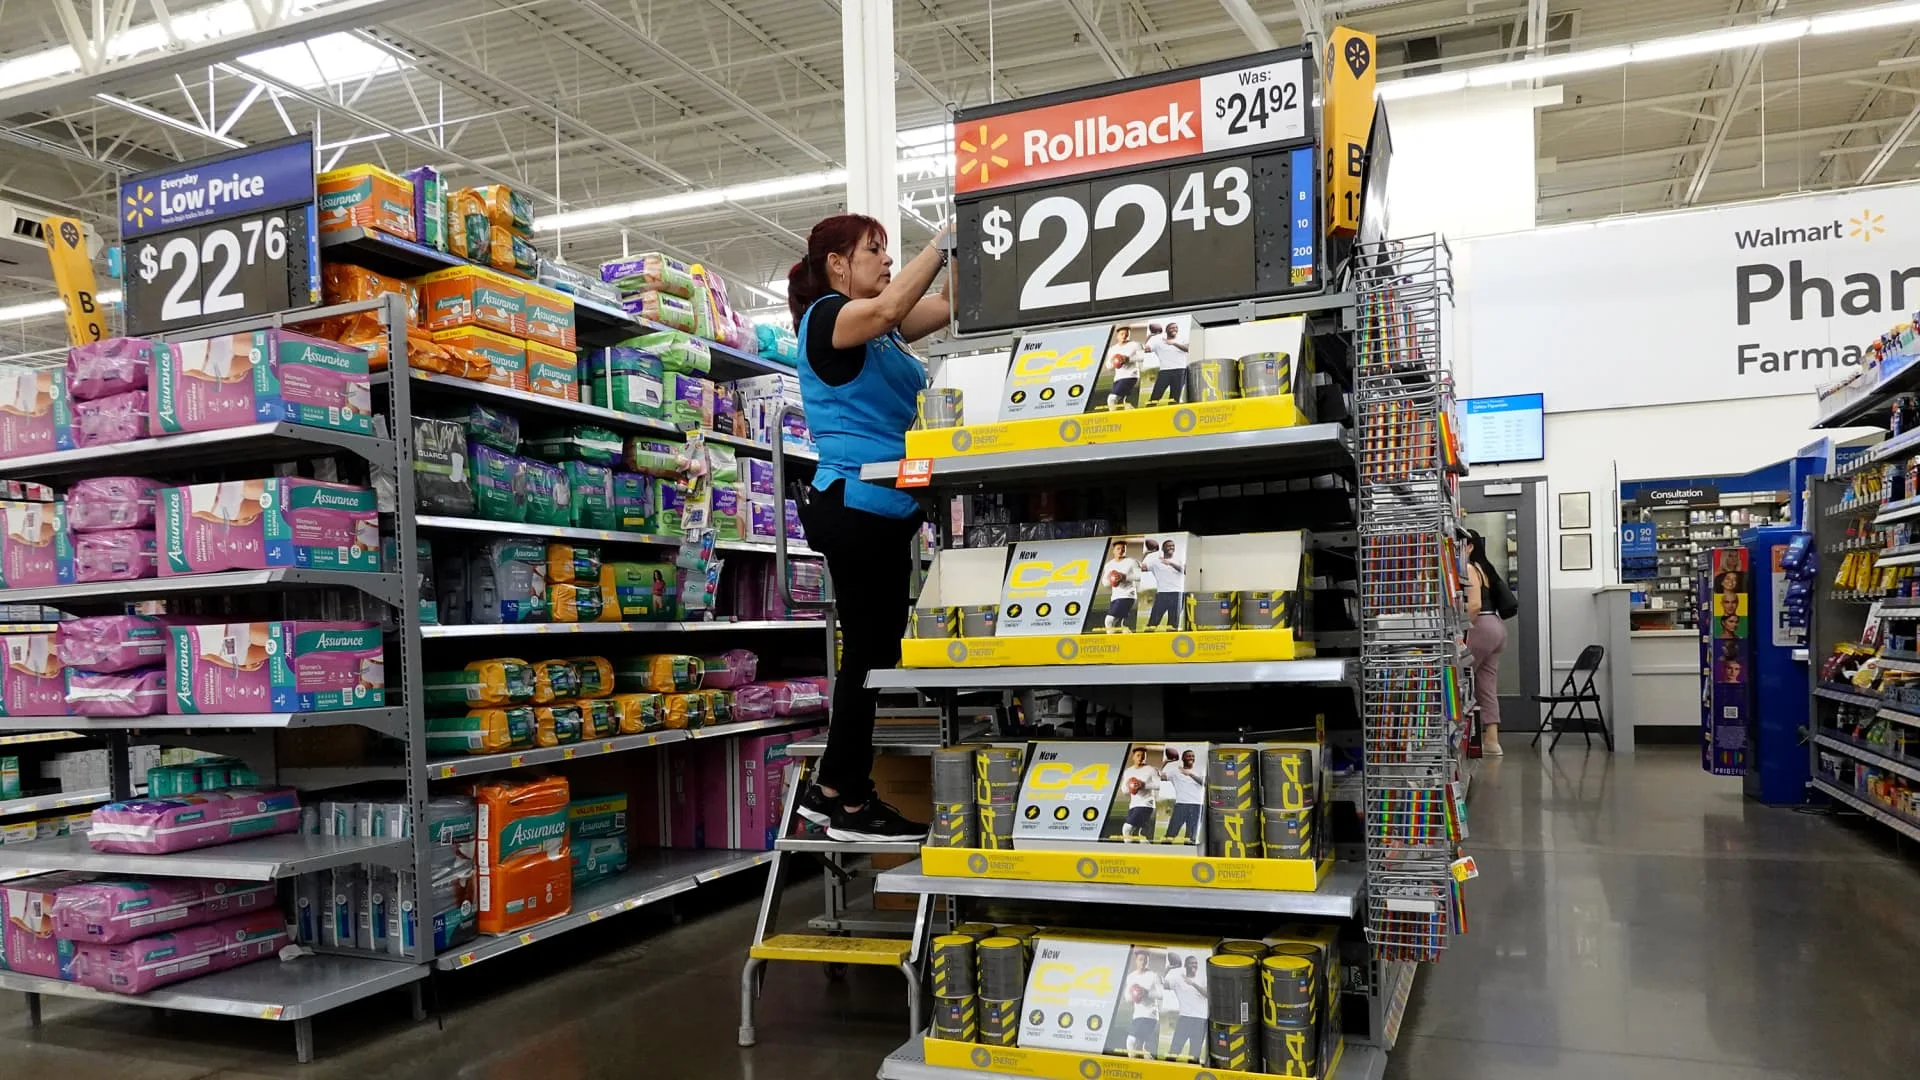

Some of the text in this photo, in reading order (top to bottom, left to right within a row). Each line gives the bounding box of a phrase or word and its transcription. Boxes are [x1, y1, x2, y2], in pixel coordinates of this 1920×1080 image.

[1238, 69, 1272, 87] Was:
[1023, 102, 1196, 167] Rollback
[160, 173, 199, 190] Everyday
[160, 173, 264, 216] Low Price
[1298, 191, 1306, 201] B
[1296, 219, 1309, 229] 10
[1735, 219, 1843, 250] Walmart
[1293, 246, 1313, 257] 200
[78, 290, 95, 314] B
[482, 289, 520, 312] Assurance
[533, 306, 569, 327] Assurance
[88, 322, 100, 342] 9
[1024, 341, 1043, 352] New
[301, 346, 350, 368] Assurance
[1013, 344, 1096, 377] C4
[537, 363, 572, 382] Assurance
[159, 352, 175, 425] Assurance
[1082, 424, 1122, 435] HYDRATION
[417, 450, 449, 461] GUARDS
[312, 489, 359, 507] Assurance
[1650, 489, 1703, 499] Consultation
[168, 493, 184, 565] Assurance
[1640, 528, 1652, 536] 90
[1019, 550, 1038, 560] New
[1009, 559, 1092, 589] C4
[315, 632, 364, 649] Assurance
[1079, 644, 1120, 654] HYDRATION
[1197, 642, 1226, 651] POWER
[177, 634, 192, 707] Assurance
[1039, 751, 1059, 761] New
[977, 753, 991, 805] C4
[1028, 762, 1111, 792] C4
[1281, 753, 1304, 809] C4
[508, 821, 566, 847] Assurance
[1224, 812, 1246, 858] C4
[1100, 865, 1141, 876] HYDRATION
[1217, 870, 1246, 879] POWER
[1041, 948, 1061, 960] New
[1031, 961, 1114, 996] C4
[1261, 969, 1277, 1028] C4
[1285, 1031, 1307, 1078] C4
[1103, 1069, 1143, 1079] HYDRATION
